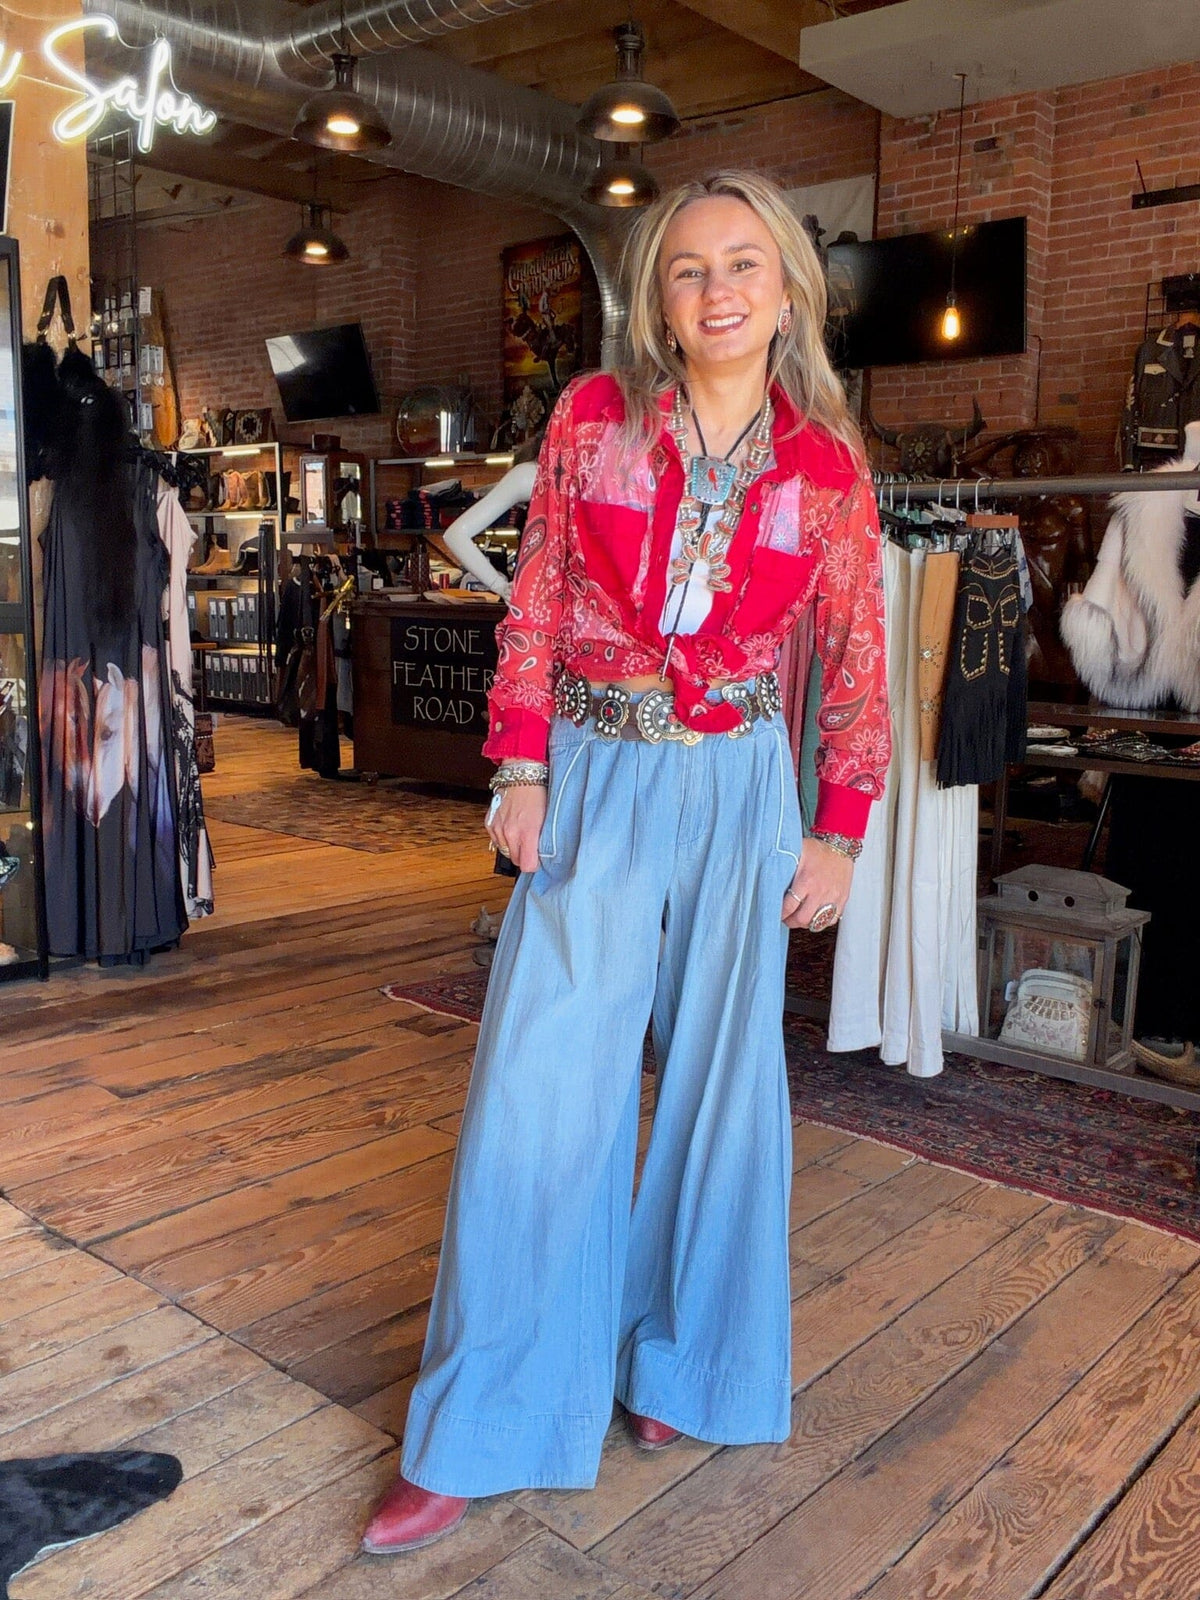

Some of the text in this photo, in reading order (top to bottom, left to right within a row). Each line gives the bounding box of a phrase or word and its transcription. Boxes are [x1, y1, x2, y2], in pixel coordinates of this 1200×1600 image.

[44, 15, 217, 153] Salon
[403, 625, 485, 655] STONE
[393, 660, 495, 693] FEATHER
[413, 695, 475, 724] ROAD
